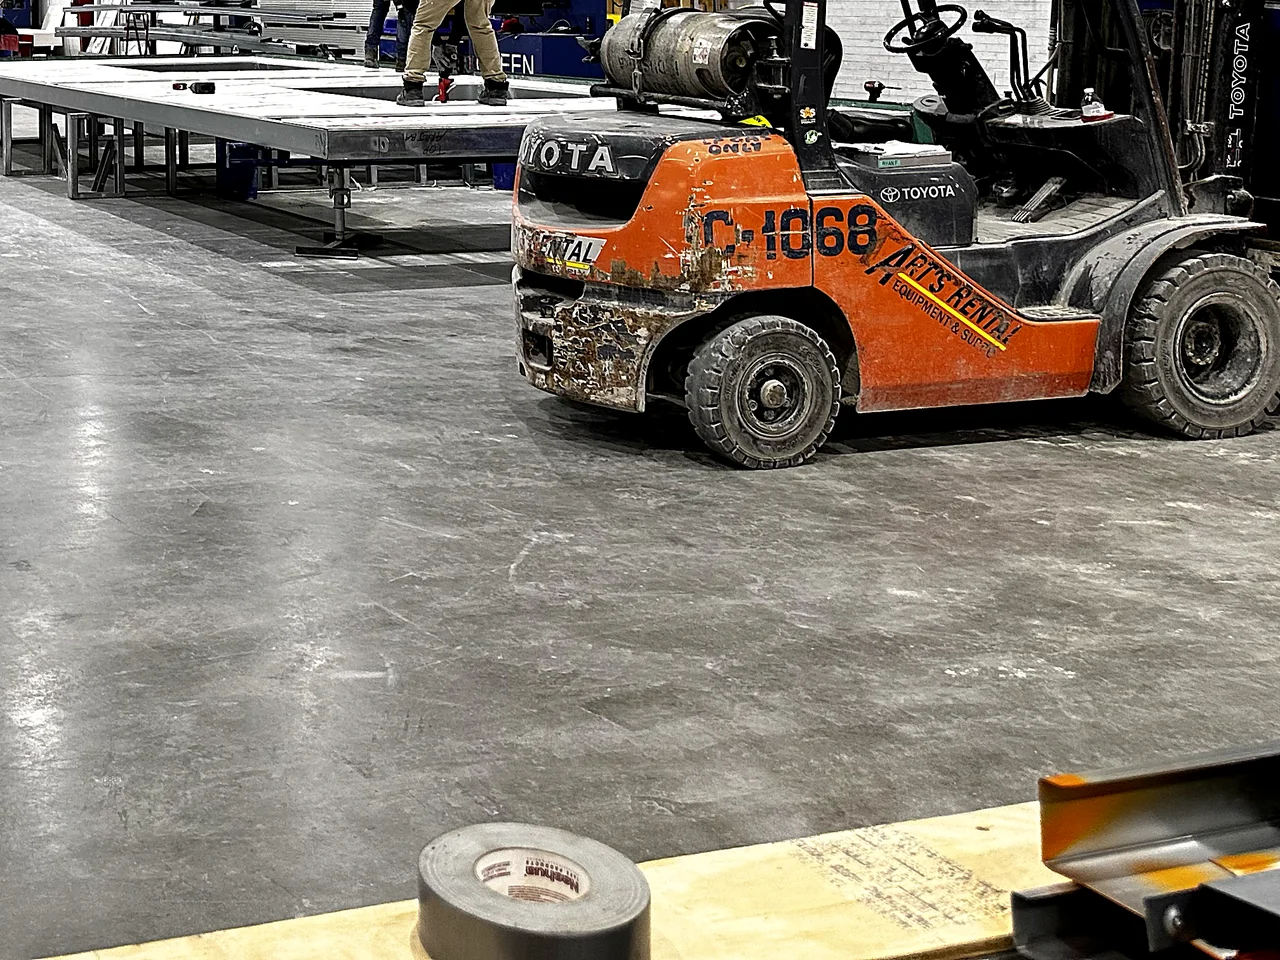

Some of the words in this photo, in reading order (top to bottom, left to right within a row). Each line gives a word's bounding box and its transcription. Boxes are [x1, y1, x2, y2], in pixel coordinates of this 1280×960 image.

[1229, 22, 1250, 120] TOYOTA
[520, 134, 617, 173] OYOTA
[708, 142, 762, 155] ONLY
[901, 185, 956, 200] TOYOTA
[536, 234, 594, 264] ENTAL
[702, 205, 879, 261] C-1068
[892, 279, 953, 326] EQUIPMENT
[951, 322, 960, 335] &
[525, 865, 580, 894] Nashua
